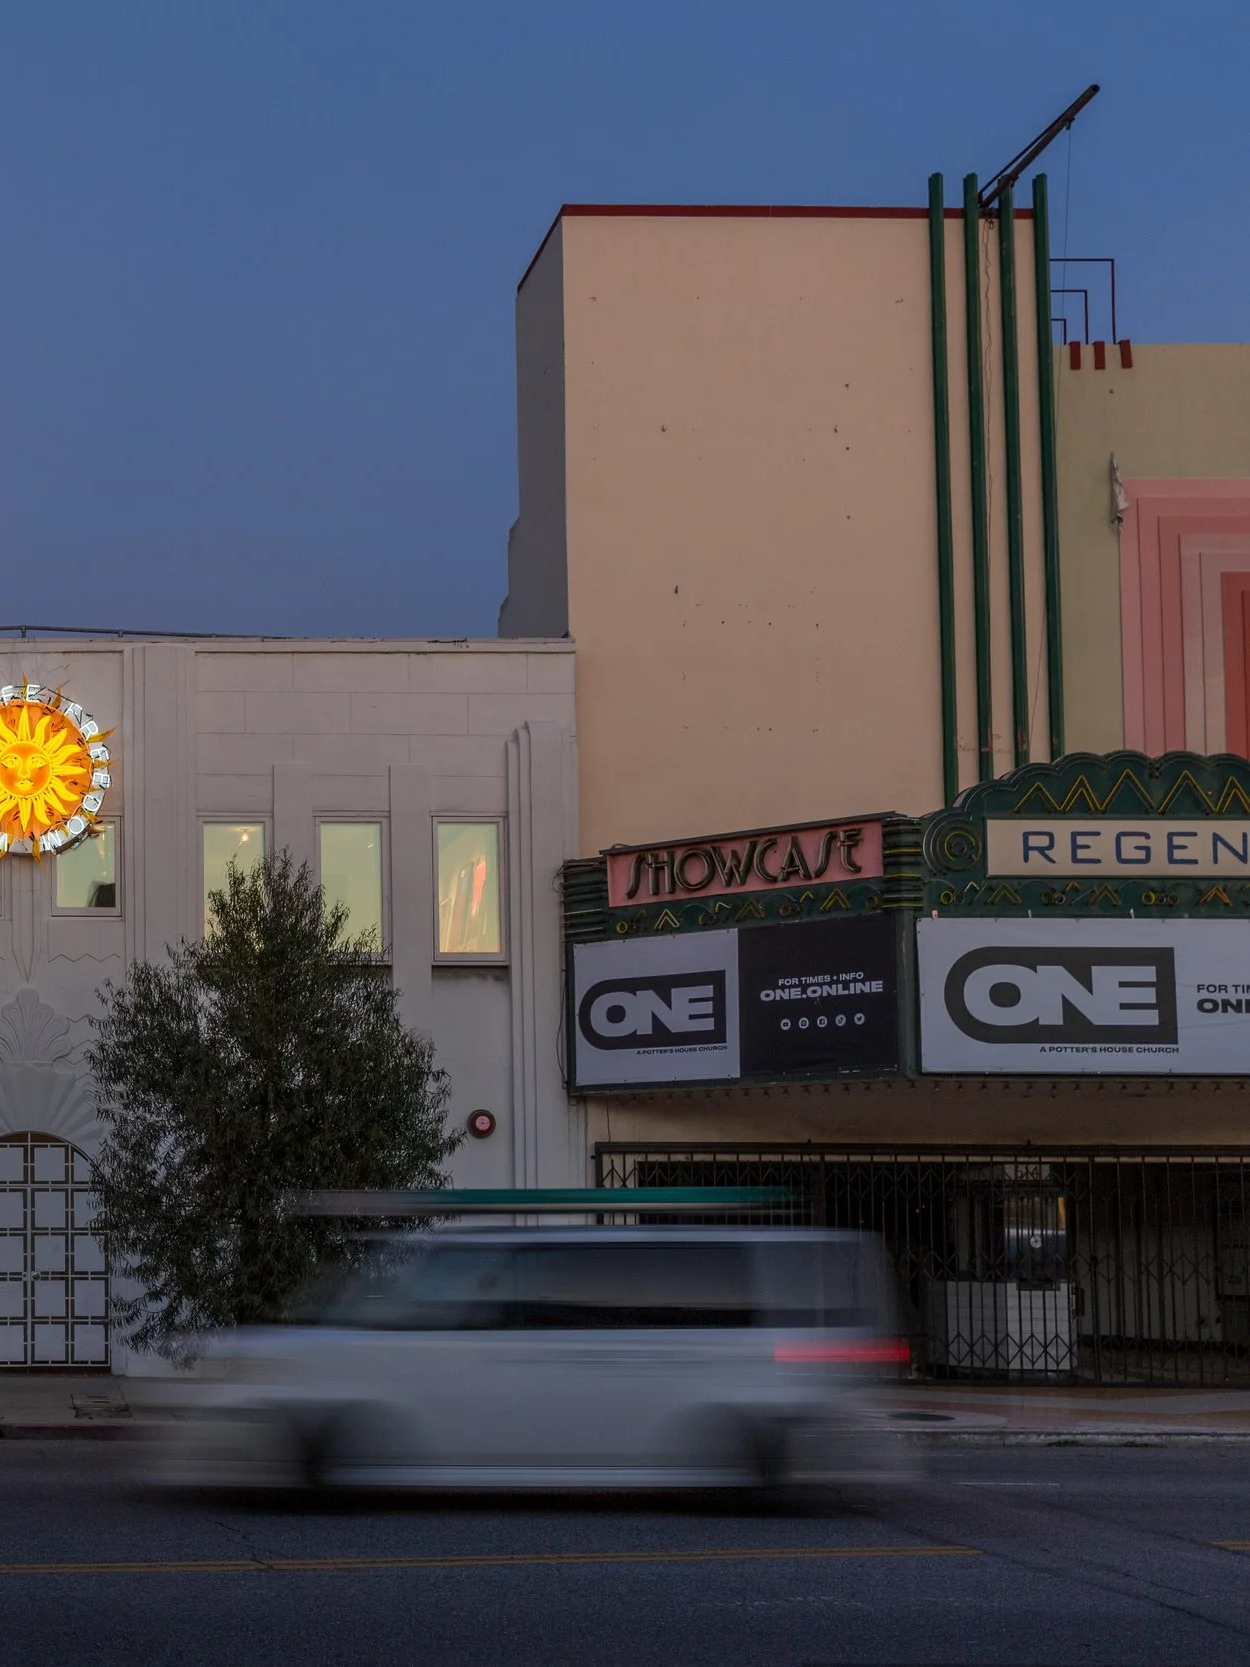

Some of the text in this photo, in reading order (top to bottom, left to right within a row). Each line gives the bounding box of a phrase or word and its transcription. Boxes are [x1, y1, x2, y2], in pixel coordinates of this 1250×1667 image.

[626, 828, 863, 899] SHOWCASE
[778, 977, 799, 987] FOR
[800, 975, 831, 985] TIMES
[839, 972, 864, 981] INFO
[1196, 984, 1228, 994] FOR
[759, 980, 884, 1001] ONE.ONLINE
[963, 964, 1159, 1026] ONE
[590, 985, 715, 1037] ONE
[1135, 1046, 1180, 1054] CHURCH
